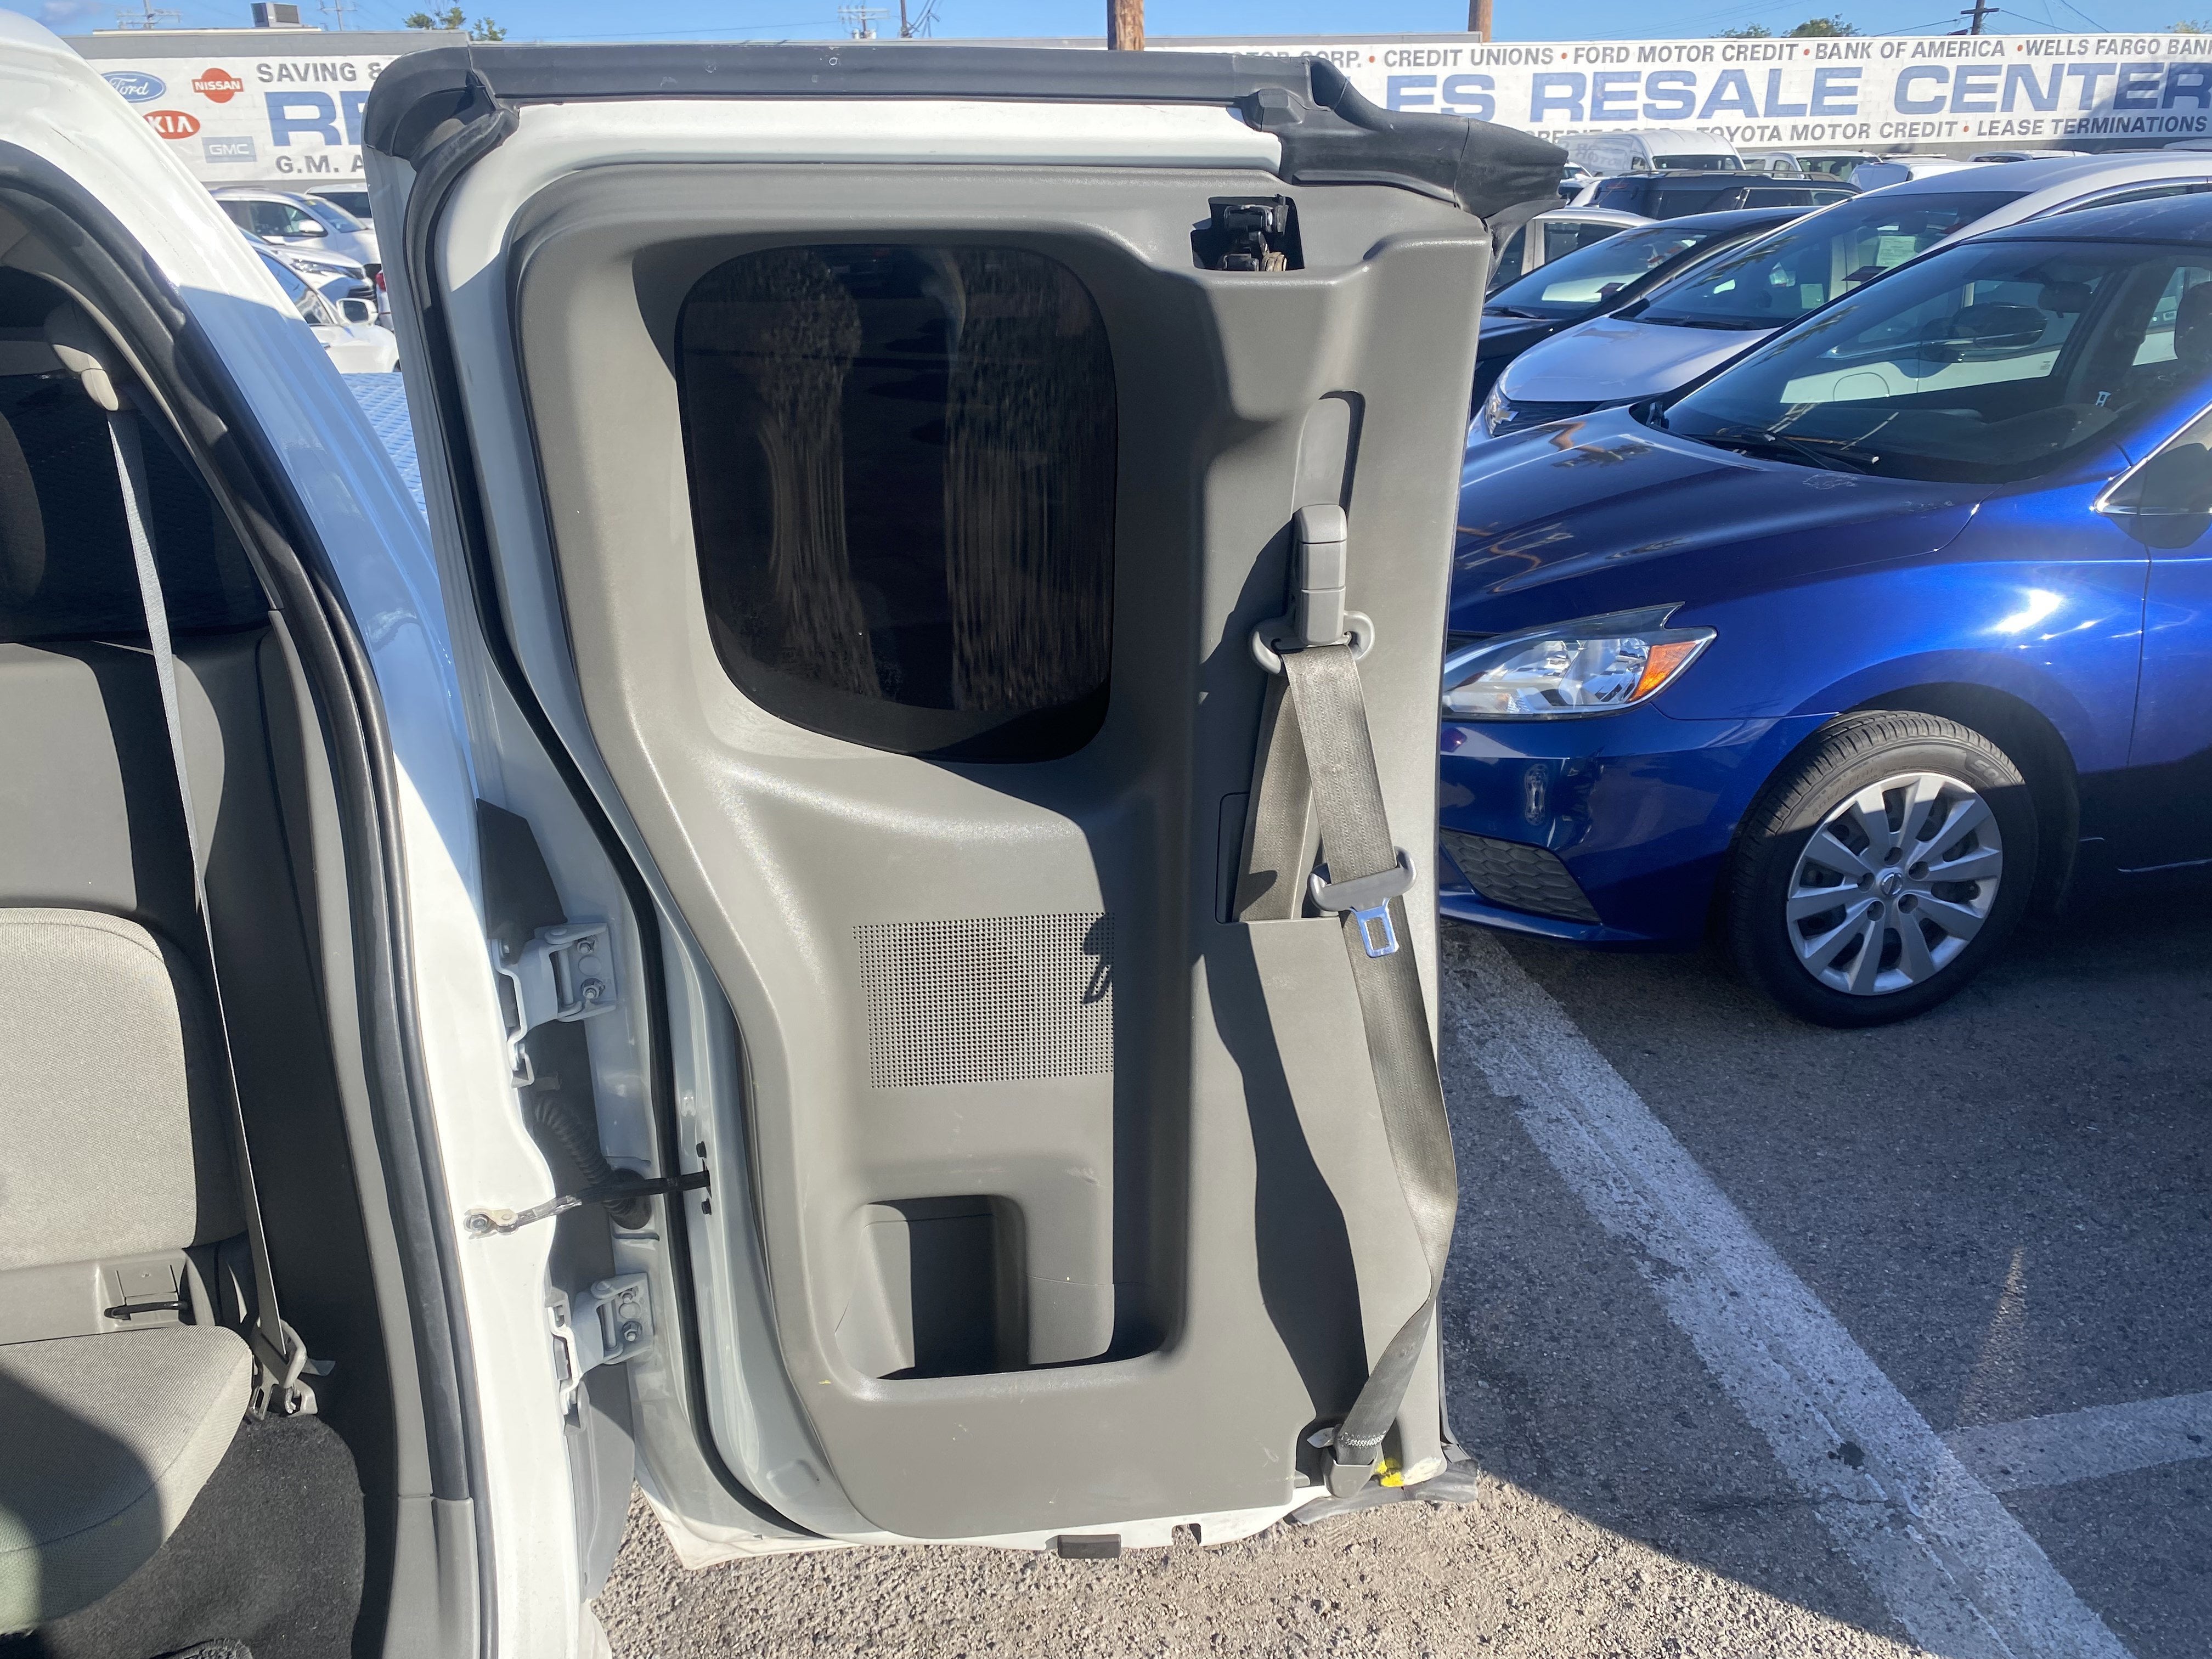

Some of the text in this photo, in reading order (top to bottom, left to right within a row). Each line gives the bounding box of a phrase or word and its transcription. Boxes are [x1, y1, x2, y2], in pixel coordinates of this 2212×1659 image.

[1300, 50, 1362, 68] RP.
[1384, 49, 1464, 67] CREDIT
[1471, 47, 1554, 66] UNIONS
[1573, 46, 1630, 64] FORD
[1637, 44, 1715, 63] MOTOR
[1722, 43, 1799, 61] CREDIT
[1815, 42, 1874, 60] BANK
[1880, 41, 1908, 59] OF
[1911, 40, 2006, 58] AMERICA
[2025, 38, 2090, 56] WELLS
[2095, 38, 2161, 55] FARGO
[256, 62, 357, 83] SAVING
[110, 77, 149, 95] Ford
[195, 81, 241, 91] NISSAN
[1386, 62, 2212, 123] ES RESALE CENTER
[147, 116, 194, 133] KIA
[1696, 116, 2208, 143] OYOTA MOTOR CREDIT LEASE TERMINATIONS
[208, 144, 250, 155] GMC
[275, 155, 339, 173] G.M.
